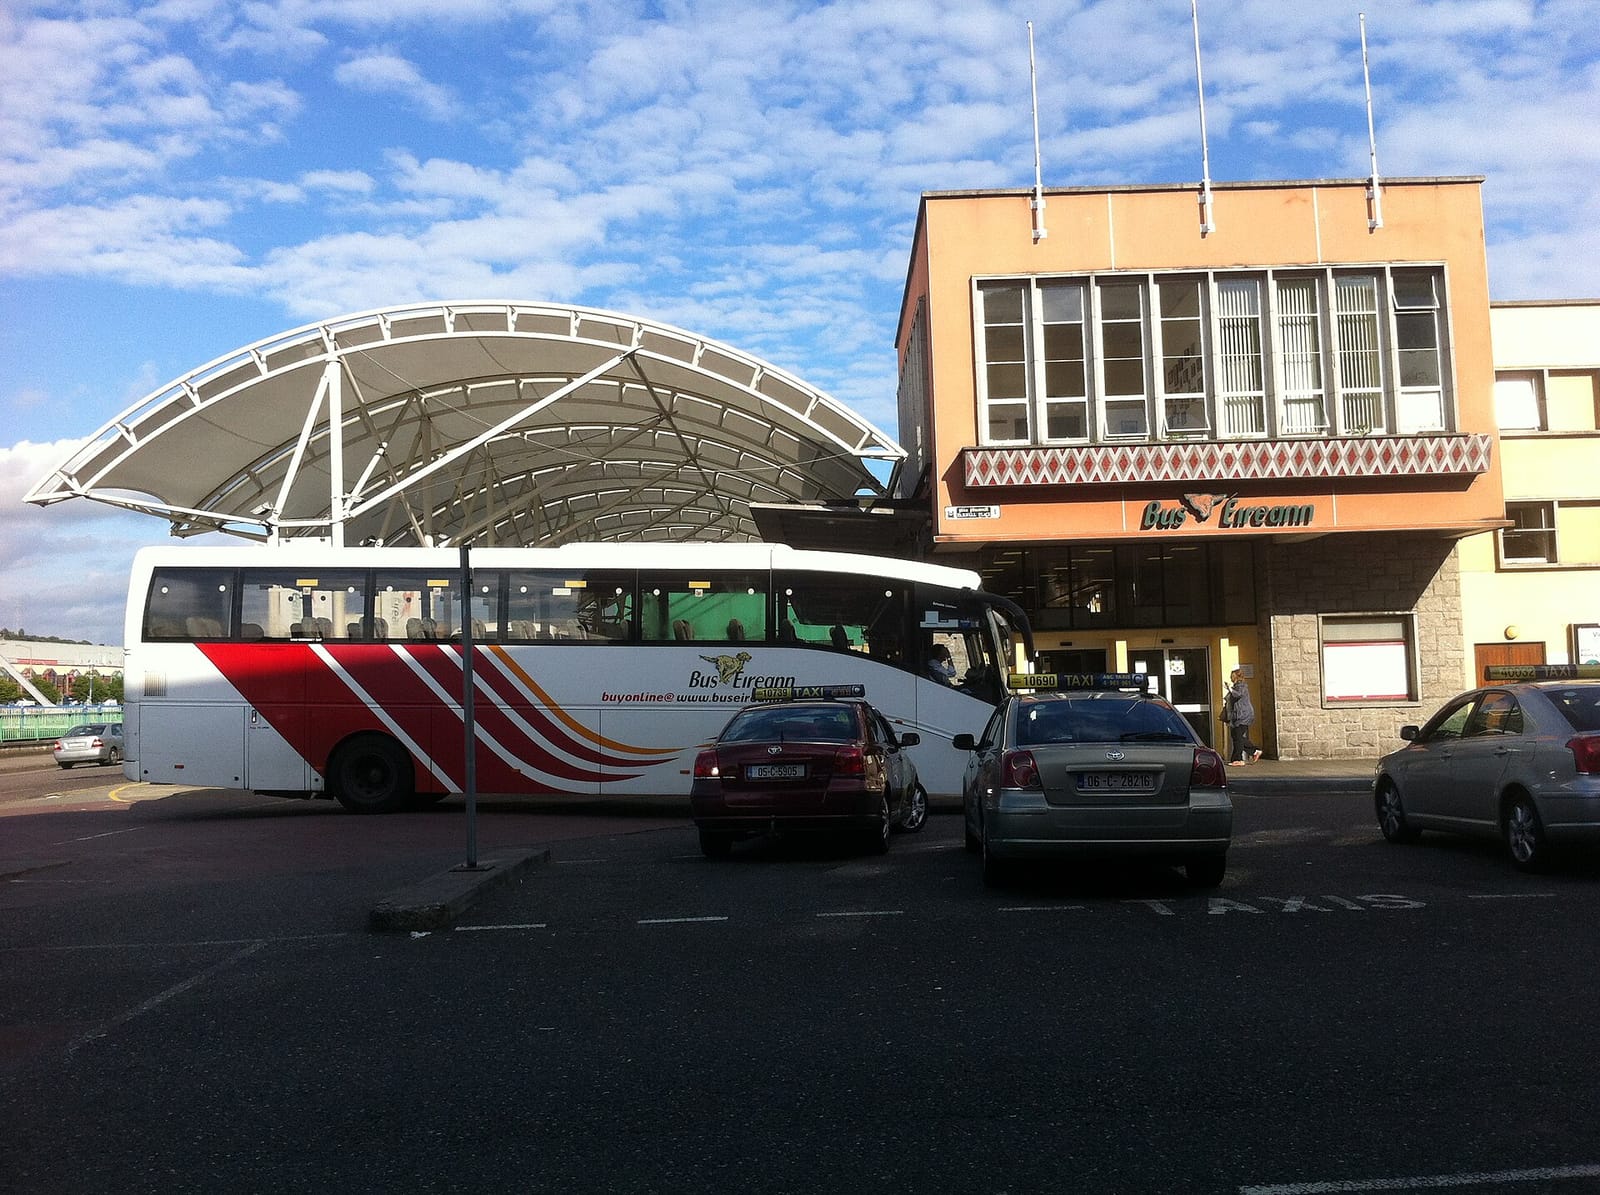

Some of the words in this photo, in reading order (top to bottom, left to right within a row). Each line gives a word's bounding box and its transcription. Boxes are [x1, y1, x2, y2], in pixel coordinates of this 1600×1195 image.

[1141, 500, 1187, 530] Bus
[1545, 665, 1571, 677] TAXI
[688, 670, 718, 689] Bus
[1023, 675, 1055, 687] 10690
[1063, 675, 1094, 687] TAXI
[763, 687, 788, 698] 10739
[794, 686, 824, 698] TAXI
